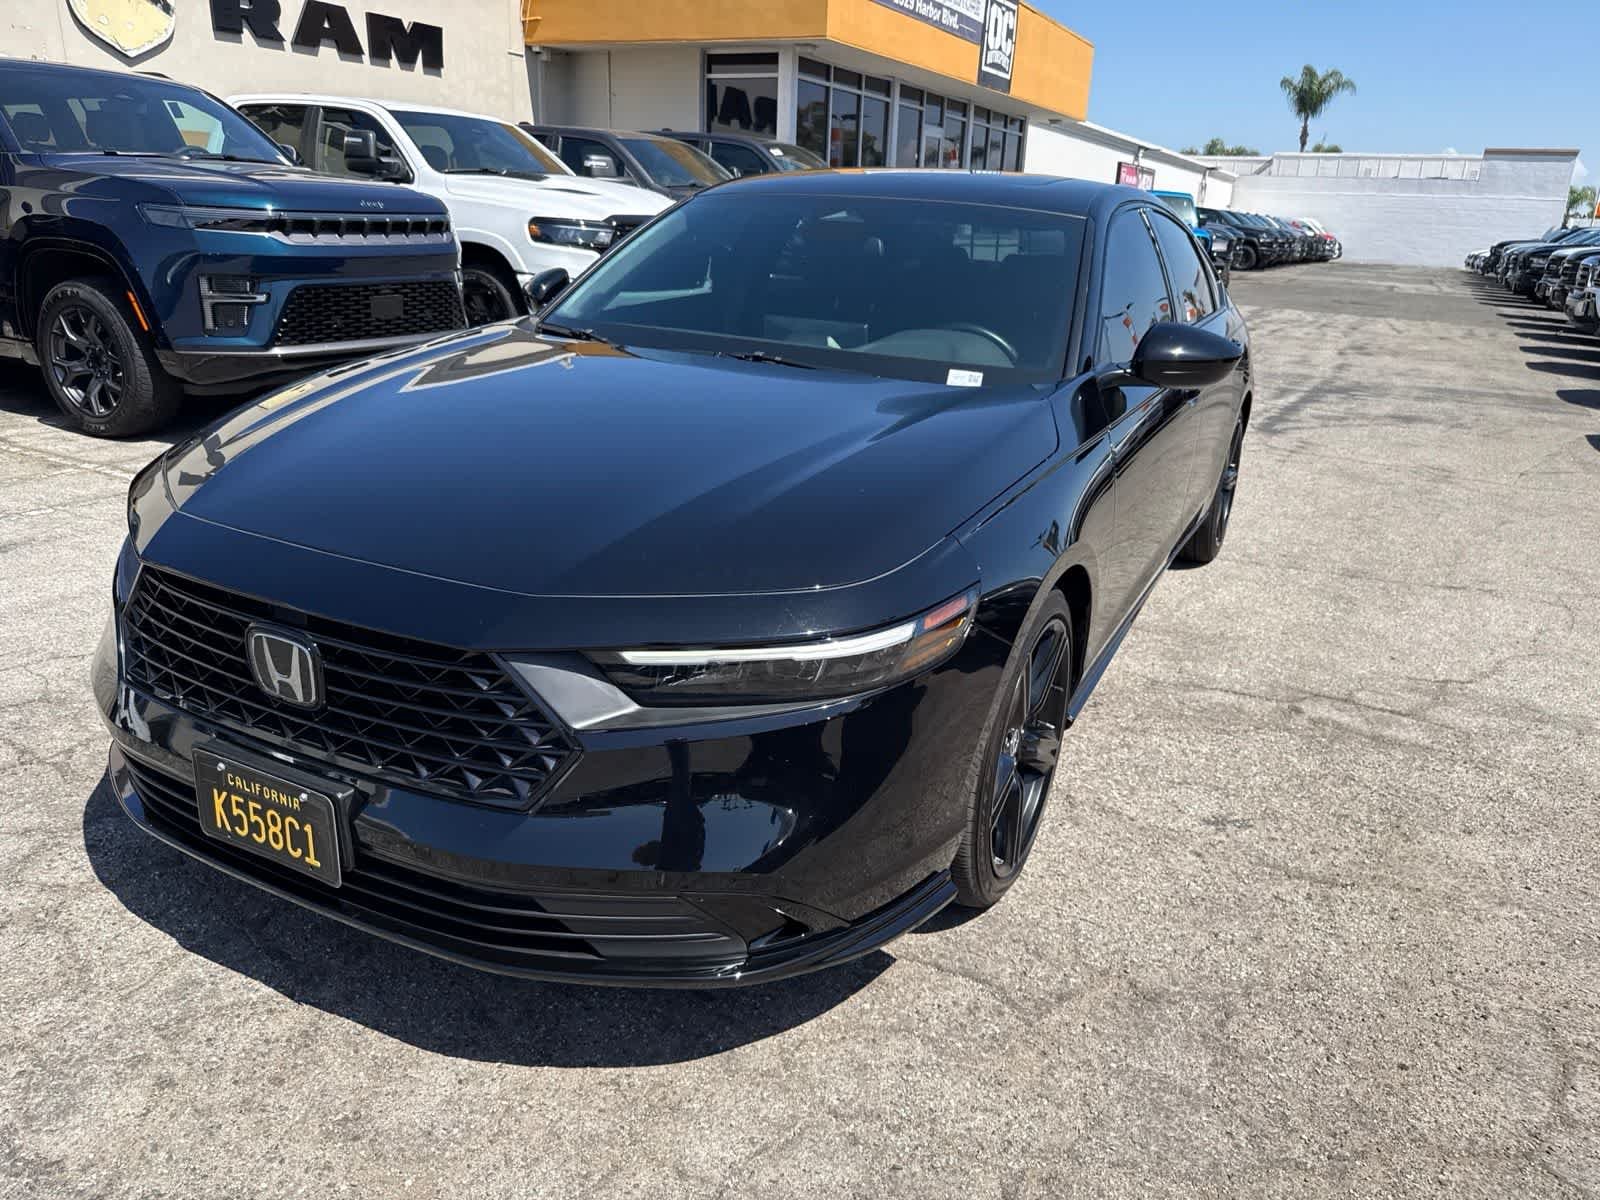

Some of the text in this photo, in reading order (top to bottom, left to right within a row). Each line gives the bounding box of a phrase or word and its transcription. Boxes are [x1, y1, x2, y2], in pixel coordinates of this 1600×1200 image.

[209, 0, 445, 69] RAM
[915, 0, 942, 23] Harbor
[942, 7, 959, 30] Blvd.
[988, 3, 1014, 57] OC
[227, 773, 301, 811] CALIFORNIA
[213, 788, 321, 868] K558C1
